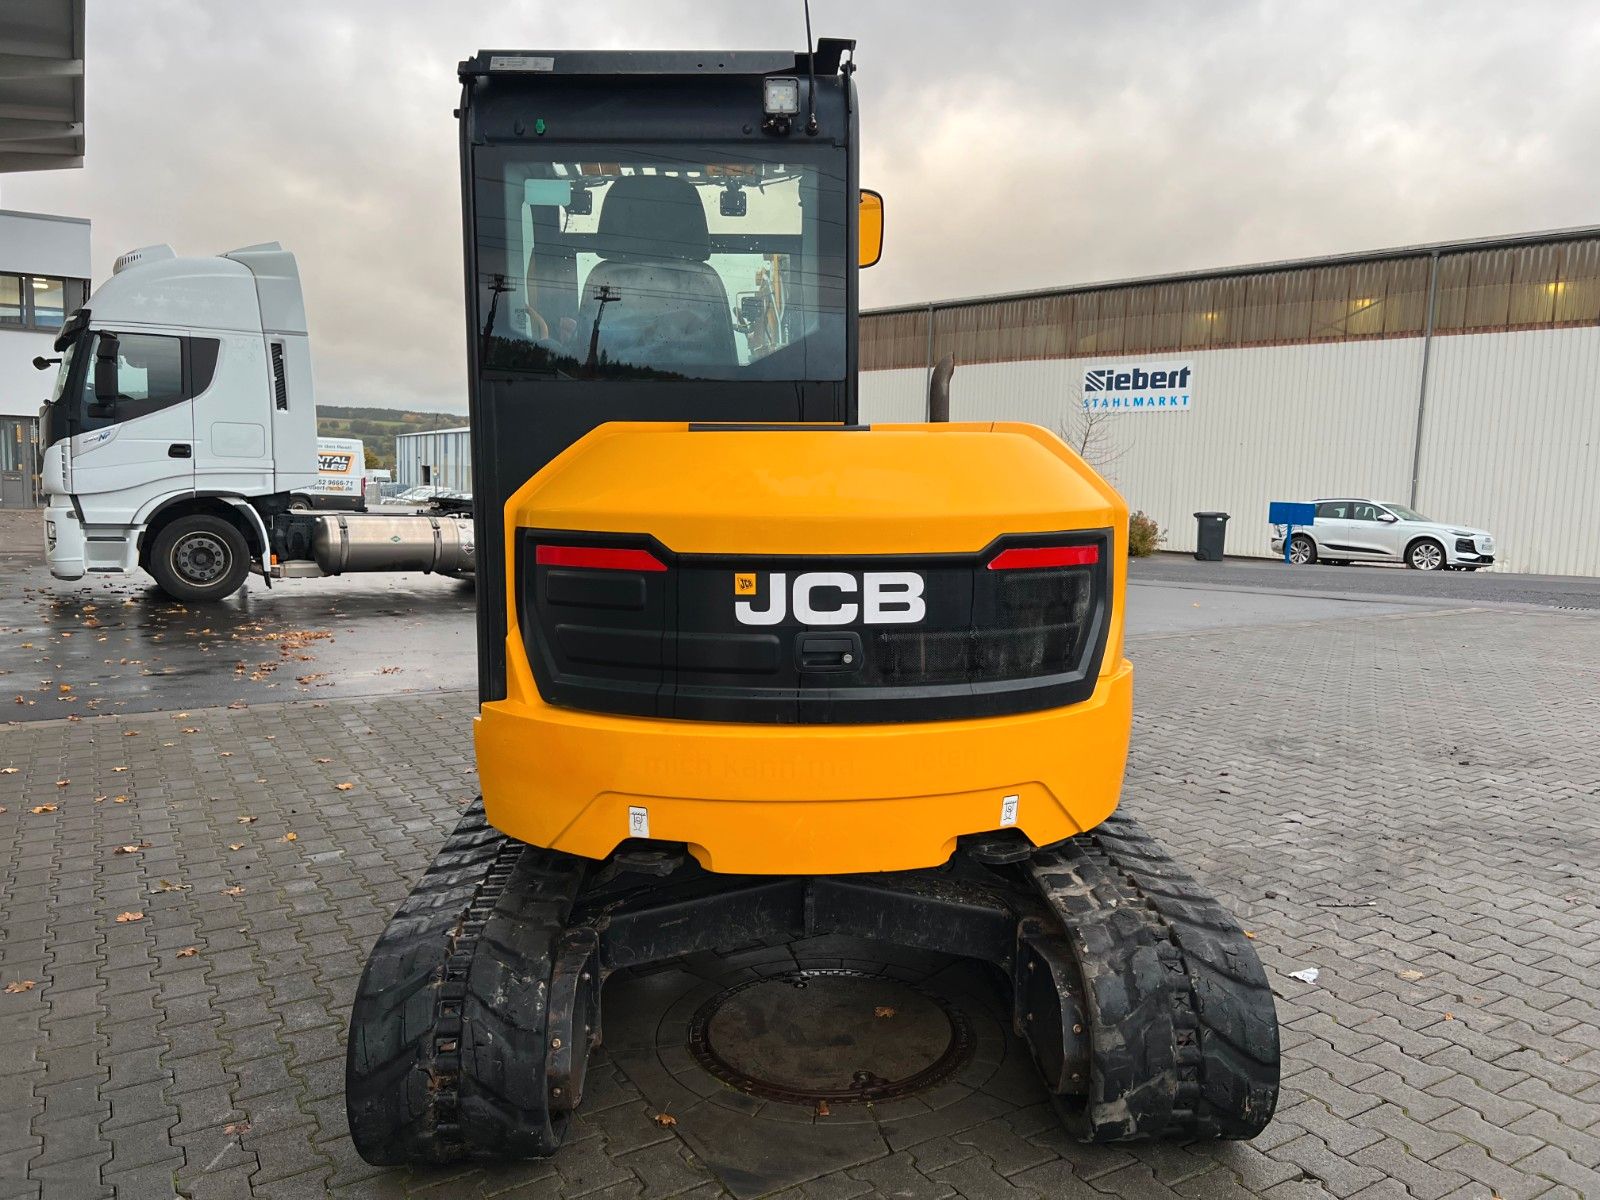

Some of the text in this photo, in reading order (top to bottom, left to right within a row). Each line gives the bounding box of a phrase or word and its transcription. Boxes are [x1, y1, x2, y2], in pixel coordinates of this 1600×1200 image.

[1085, 366, 1191, 391] Siebert
[1084, 396, 1189, 408] STAHLMARKT
[737, 577, 753, 591] JCB
[735, 572, 926, 625] JCB
